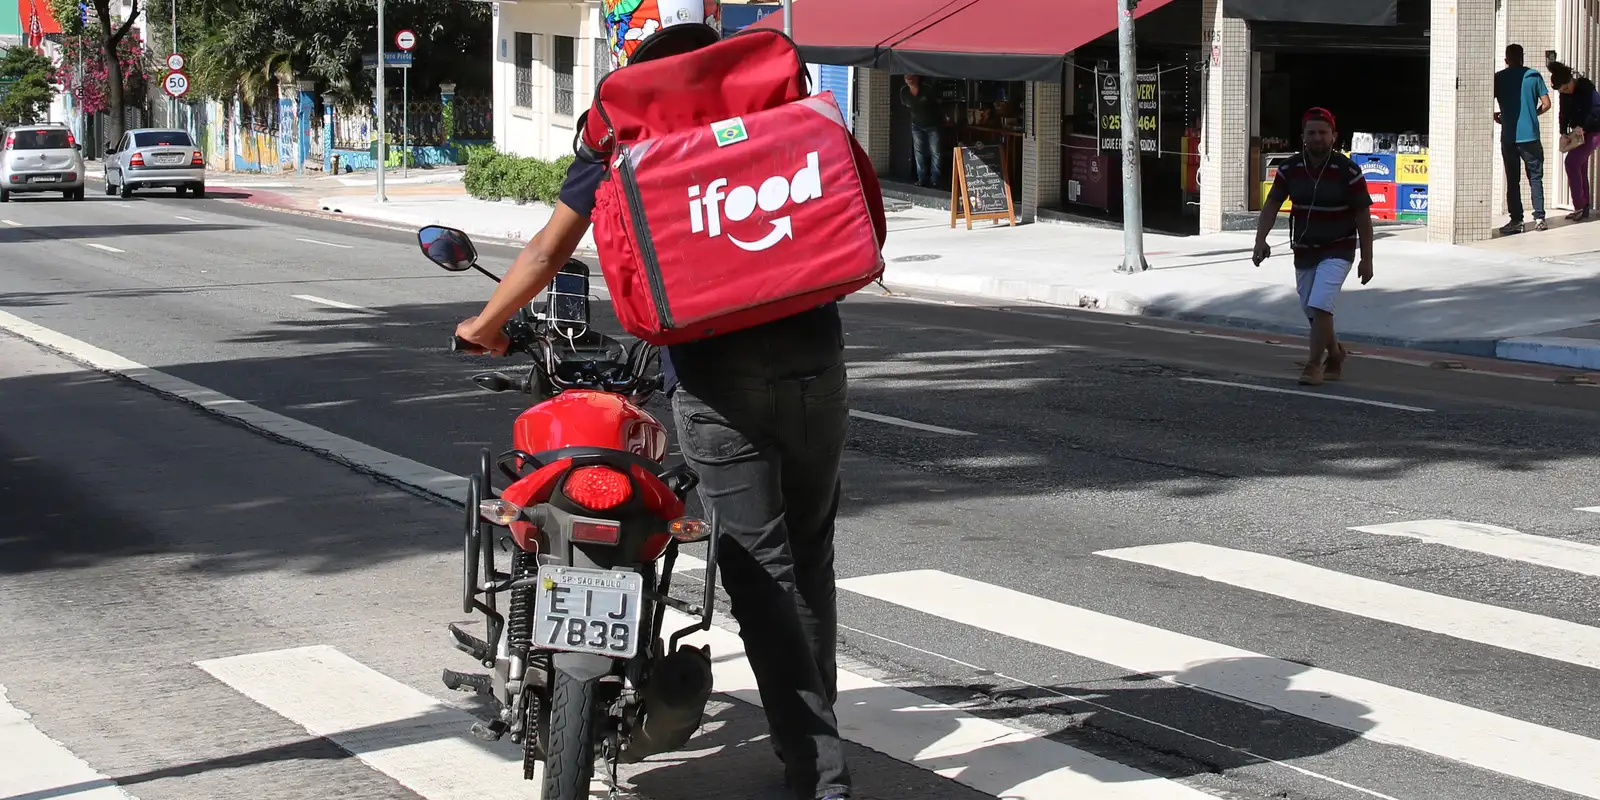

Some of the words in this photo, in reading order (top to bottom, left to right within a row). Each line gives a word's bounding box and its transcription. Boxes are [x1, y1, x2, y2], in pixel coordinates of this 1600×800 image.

[169, 77, 185, 88] 50
[1137, 84, 1156, 99] VERY
[1403, 164, 1428, 174] SKO
[687, 150, 823, 238] ifood
[595, 578, 621, 588] PAULO
[546, 615, 630, 652] 7839
